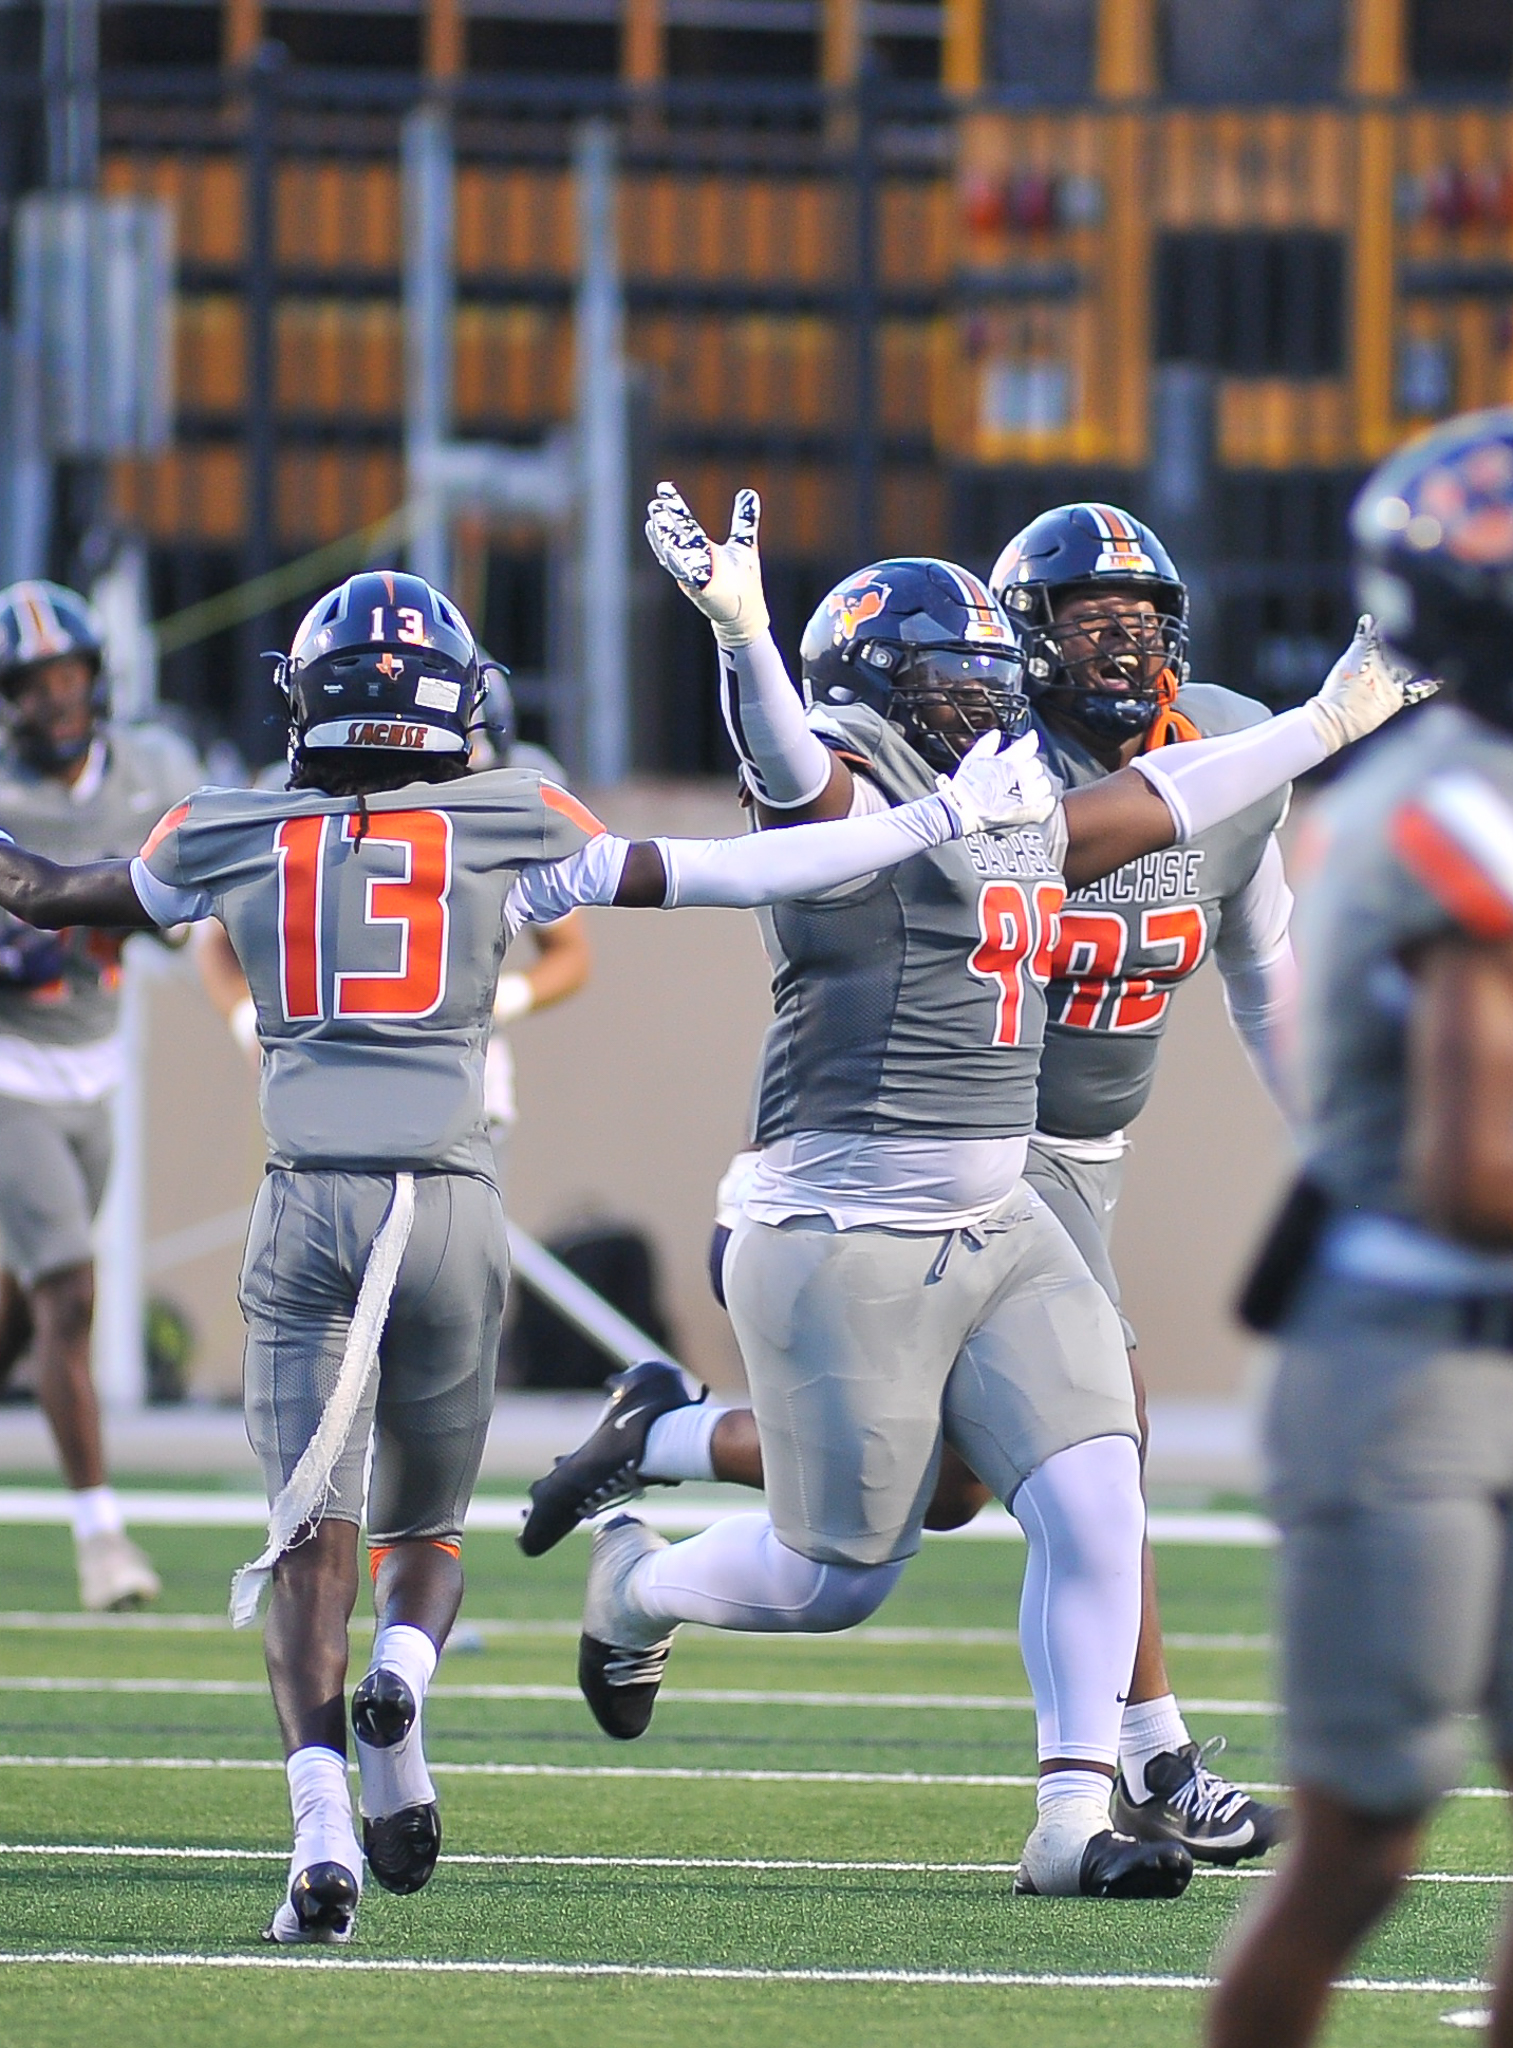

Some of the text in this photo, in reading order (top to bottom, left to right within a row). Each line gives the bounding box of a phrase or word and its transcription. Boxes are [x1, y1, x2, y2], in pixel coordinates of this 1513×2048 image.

[371, 606, 425, 646] 13
[344, 722, 429, 749] SACHSE
[961, 831, 1060, 877] SACHSE
[1066, 850, 1205, 903] ACHSE
[272, 808, 454, 1023] 13
[1050, 903, 1208, 1032] 92
